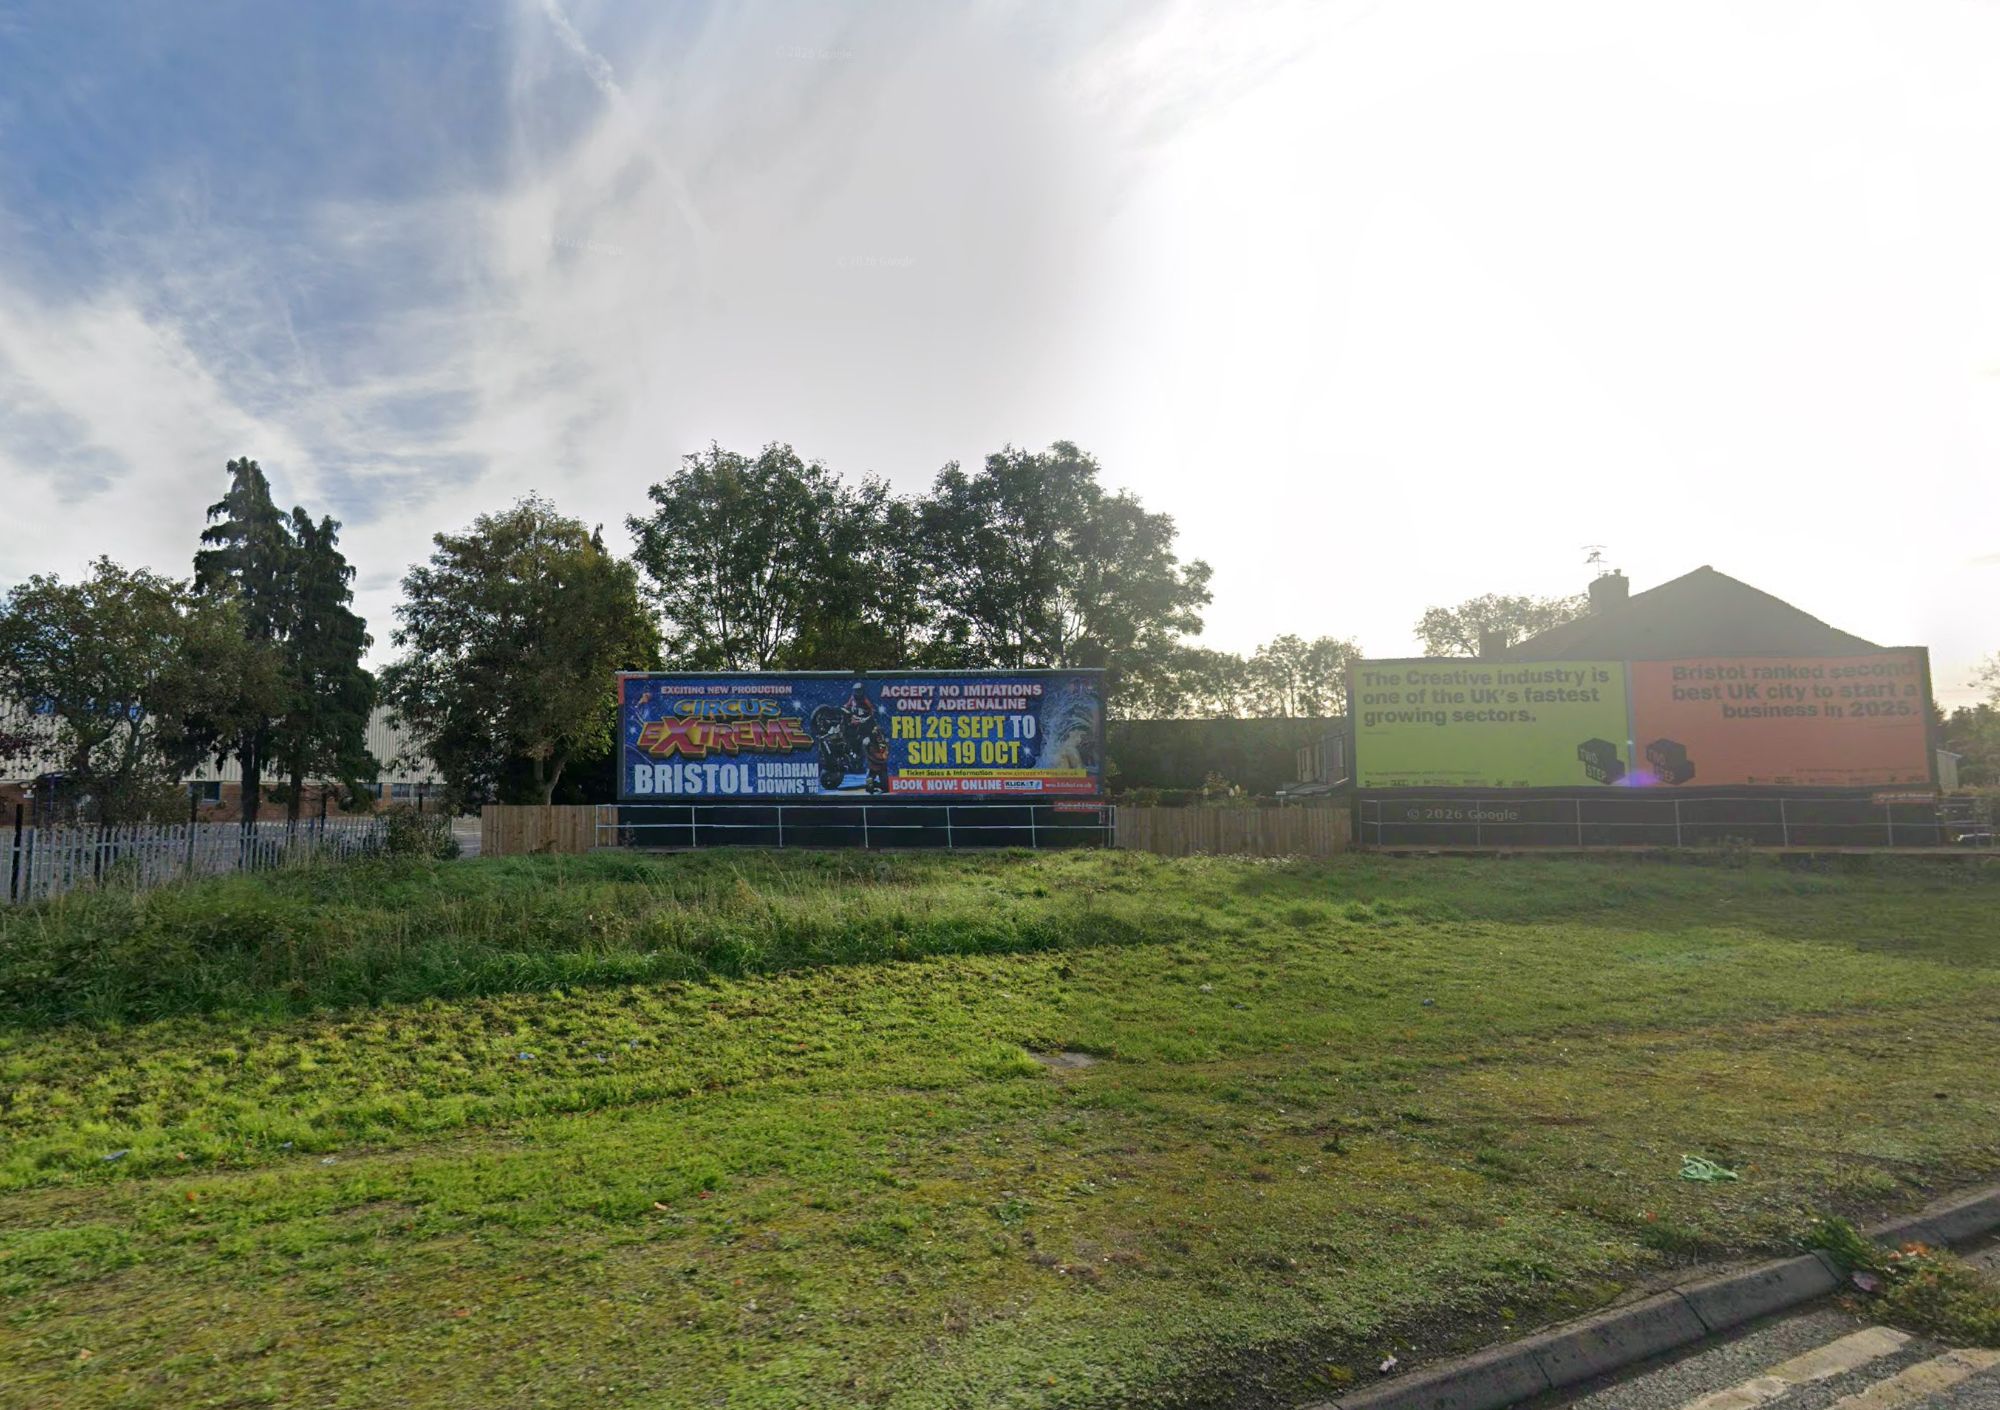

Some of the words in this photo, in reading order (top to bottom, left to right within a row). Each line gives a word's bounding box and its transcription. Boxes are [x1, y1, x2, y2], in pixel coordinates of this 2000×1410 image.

[1362, 671, 1401, 686] The
[1406, 669, 1492, 686] Creative
[1592, 667, 1609, 683] is
[1672, 664, 1747, 681] Bristol
[1752, 663, 1824, 680] ranked
[1829, 661, 1916, 679] second
[661, 686, 705, 695] EXCITING
[708, 686, 729, 694] NEW
[731, 685, 792, 694] PRODUCTION
[880, 685, 935, 698] ACCEPT
[939, 685, 960, 697] NO
[964, 684, 1042, 697] IMITATIONS
[1362, 691, 1400, 705] one
[1405, 688, 1427, 704] of
[1431, 689, 1464, 704] the
[1524, 687, 1600, 703] fastest
[1672, 684, 1722, 701] best
[1727, 683, 1760, 699] UK
[1766, 681, 1807, 701] city
[1813, 683, 1834, 698] to
[1840, 681, 1897, 697] start
[1903, 684, 1916, 697] a
[673, 699, 782, 717] CIRCUS
[897, 699, 932, 711] ONLY
[937, 698, 1026, 711] ADRENALINE
[1722, 702, 1818, 719] business
[1823, 702, 1843, 718] in
[1849, 701, 1919, 718] 2025.
[1363, 708, 1448, 727] growing
[1452, 707, 1537, 723] sectors.
[891, 716, 921, 739] FRI
[927, 716, 952, 738] 26
[957, 716, 1006, 738] SEPT
[1010, 715, 1036, 739] TO
[637, 716, 815, 758] EXTREME
[908, 741, 942, 765] SUN
[952, 741, 975, 765] 19
[981, 741, 1020, 764] OCT
[634, 763, 753, 794] BRISTOL
[757, 763, 819, 777] DURDHAM
[758, 779, 804, 793] DOWNS
[892, 779, 924, 791] BOOK
[927, 779, 958, 791] NOW!
[961, 779, 1002, 791] ONLINE
